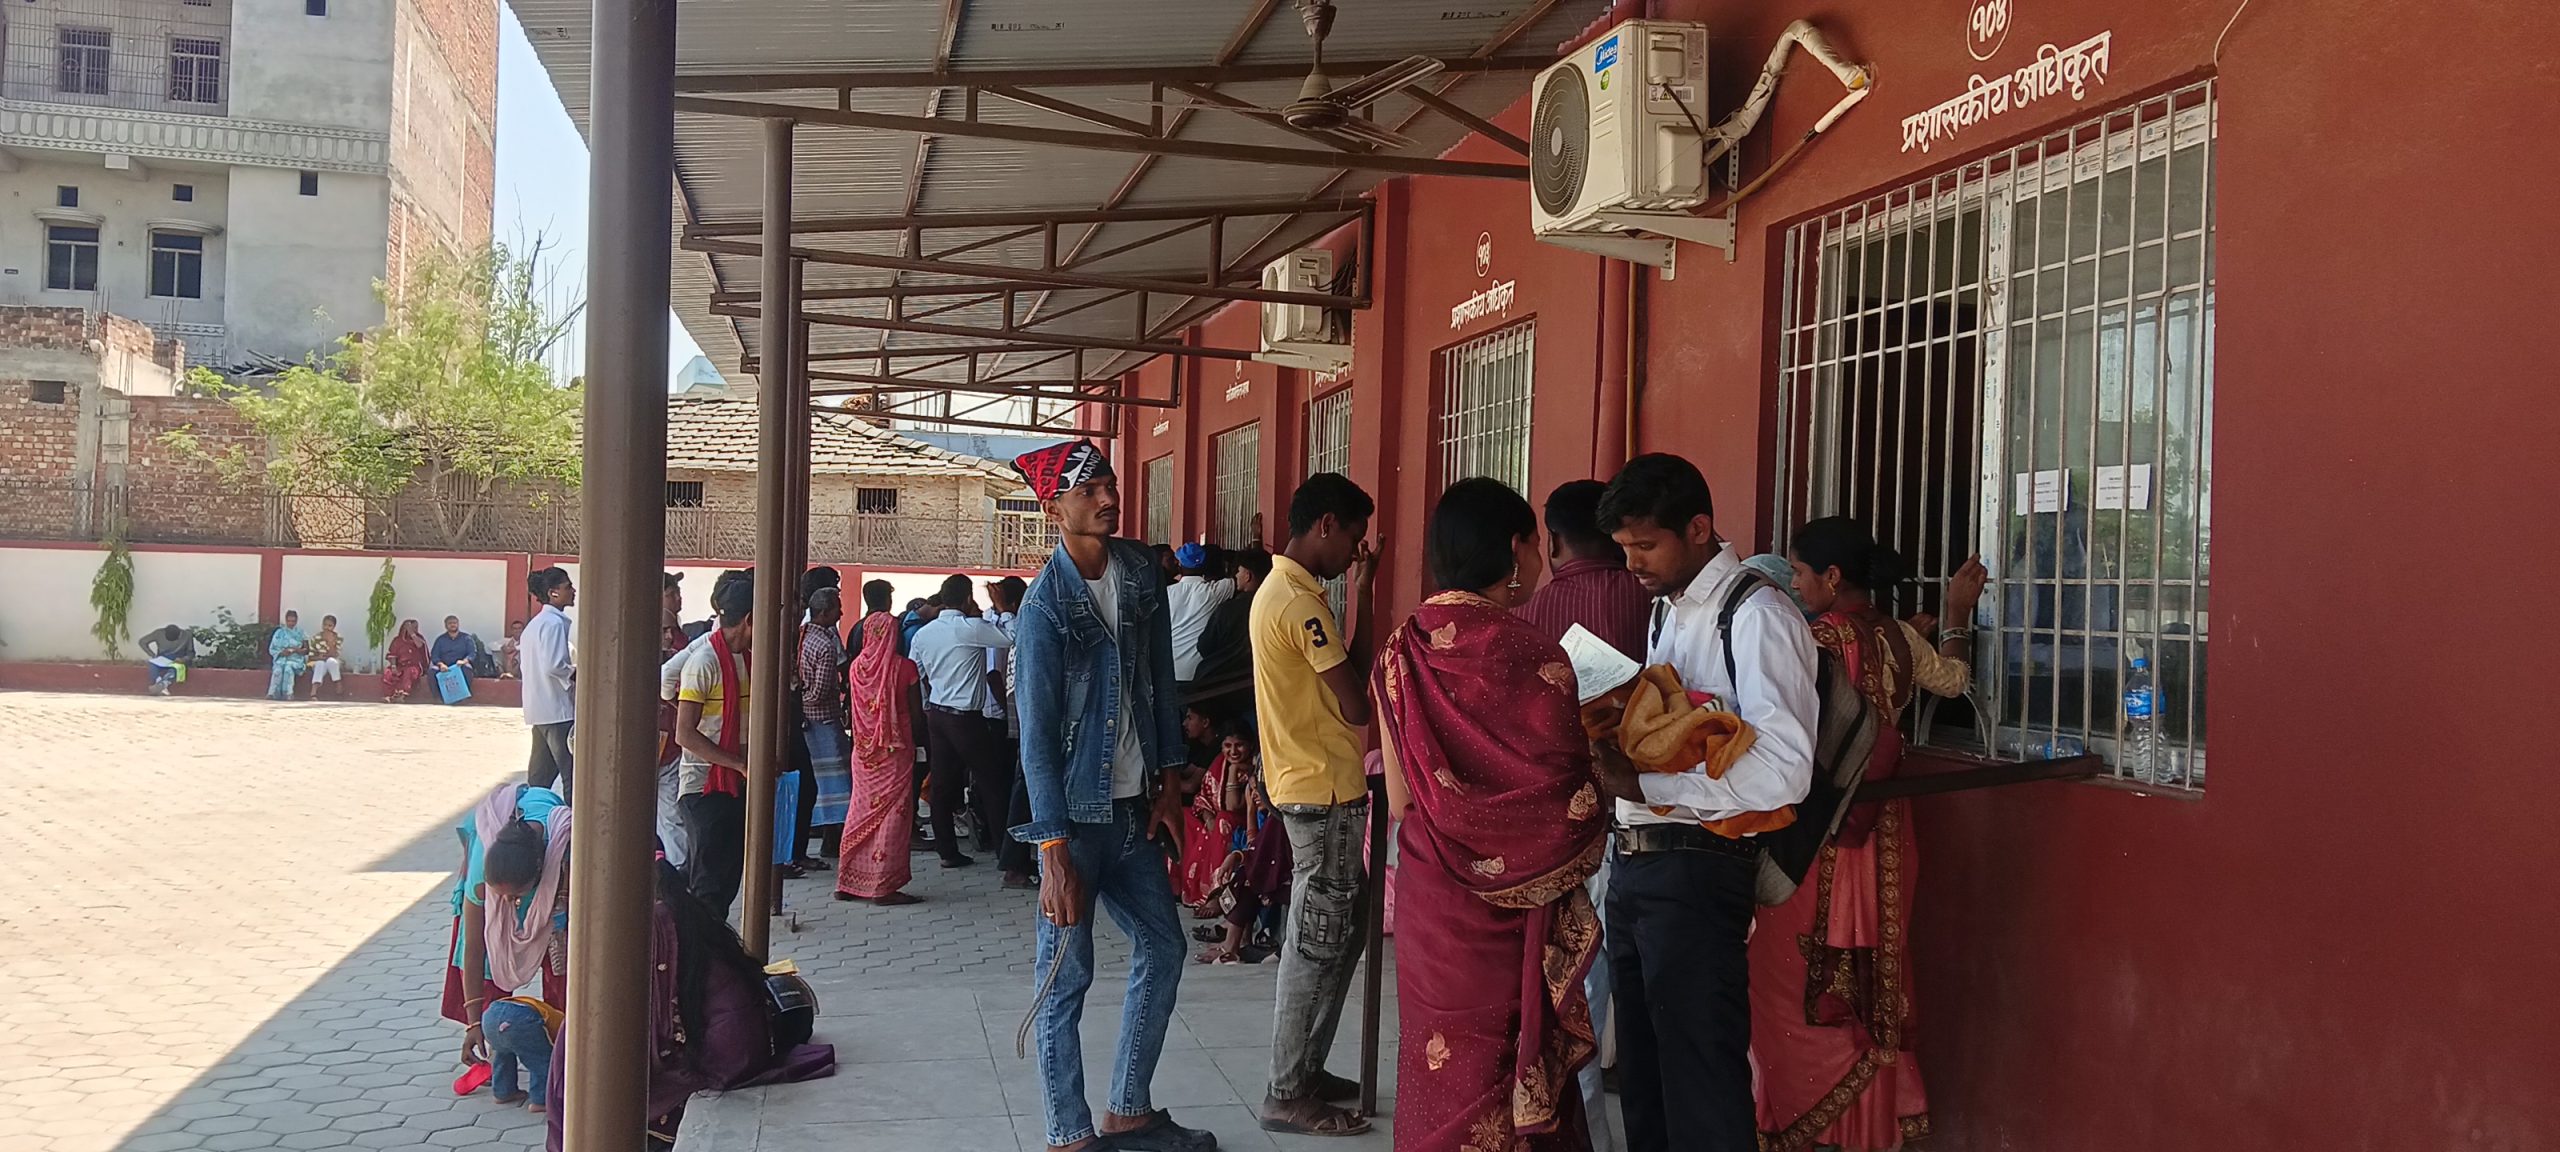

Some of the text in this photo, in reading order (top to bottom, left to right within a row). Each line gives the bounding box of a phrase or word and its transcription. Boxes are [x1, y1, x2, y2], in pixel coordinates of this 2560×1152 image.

[1972, 0, 2007, 42] १०४
[1901, 30, 2112, 153] प्रशासकीय अधिकृत
[1304, 617, 1328, 648] 3
